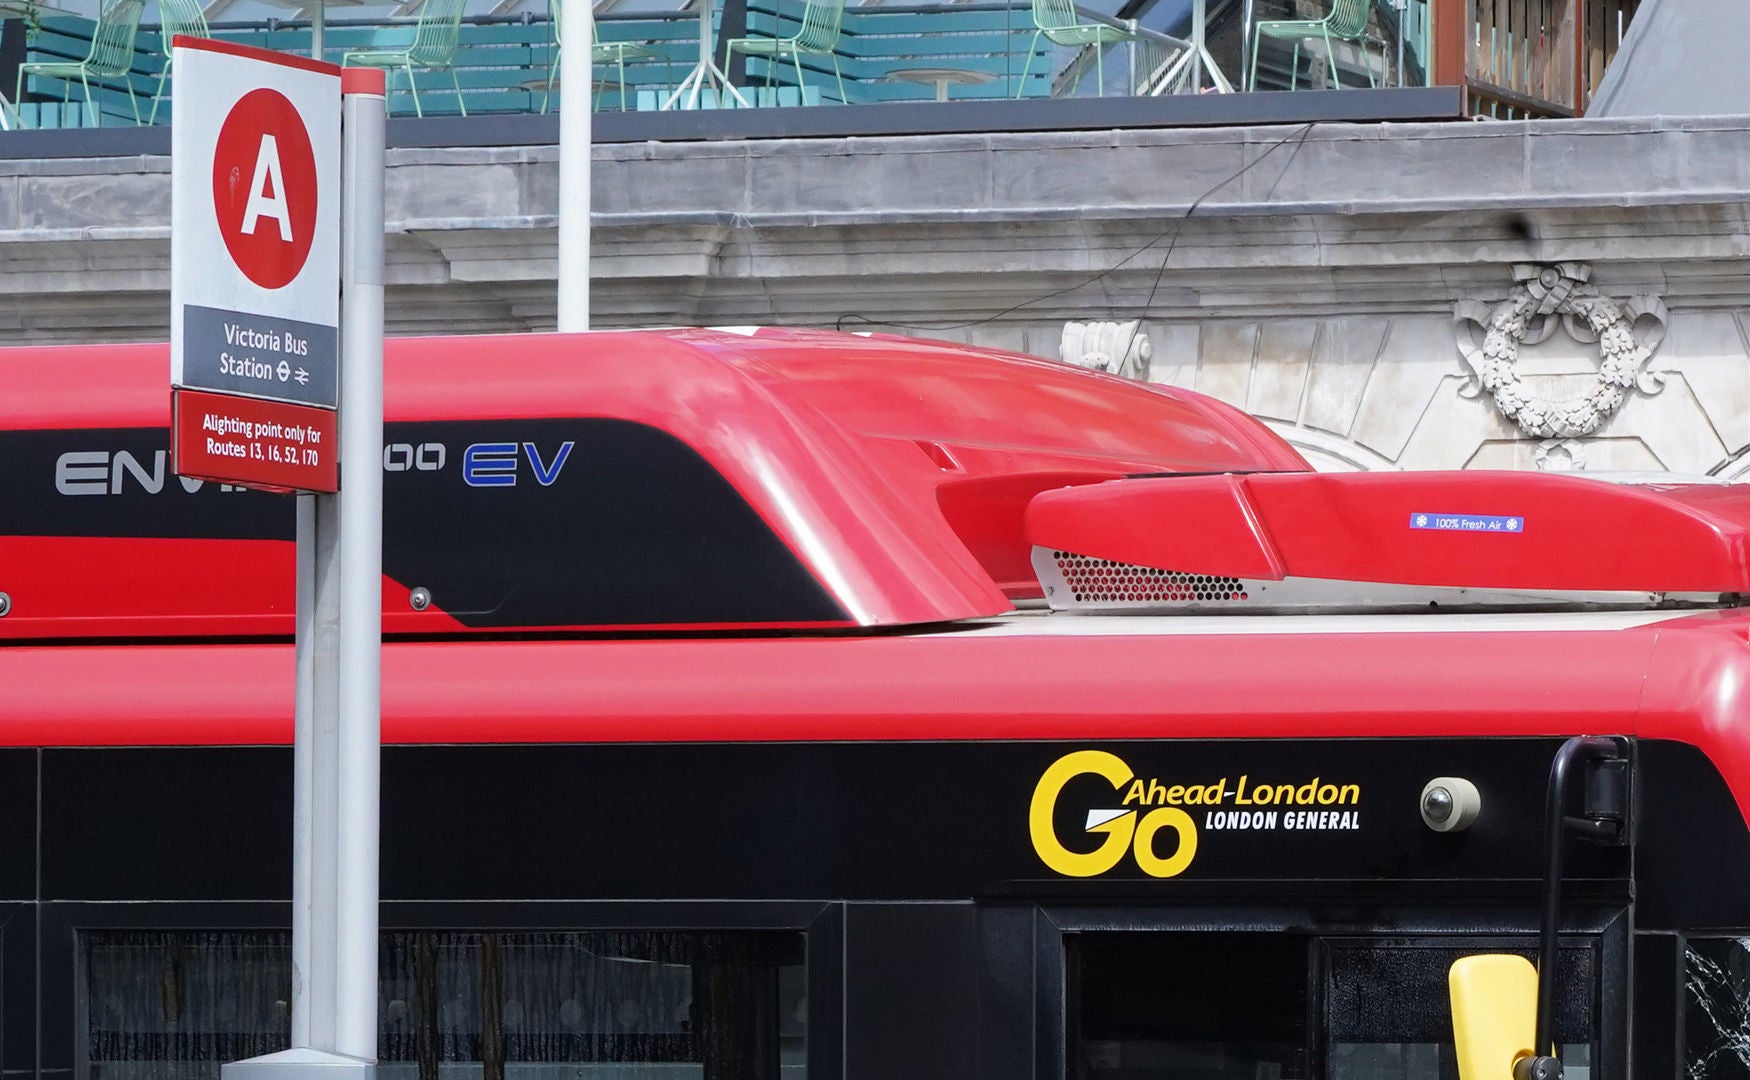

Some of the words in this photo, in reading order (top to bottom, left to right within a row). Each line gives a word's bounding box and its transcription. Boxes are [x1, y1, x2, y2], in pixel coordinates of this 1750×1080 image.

[241, 134, 293, 242] A
[224, 323, 280, 351] Victoria
[285, 333, 307, 355] Bus
[220, 353, 272, 380] Station
[203, 414, 252, 438] Alighting
[255, 422, 282, 439] point
[284, 425, 306, 445] only
[307, 426, 321, 444] for
[207, 438, 246, 458] Routes
[250, 443, 265, 461] 13,
[268, 445, 282, 462] 16,
[285, 446, 300, 465] 52,
[302, 450, 318, 466] 170
[463, 441, 575, 487] EV
[1435, 518, 1459, 529] 100%
[1461, 519, 1485, 530] Fresh
[1488, 520, 1501, 531] Air
[1122, 776, 1360, 805] Ahead-London
[1029, 749, 1197, 878] Go
[1205, 810, 1277, 831] LONDON
[1283, 810, 1360, 831] GENERAL
